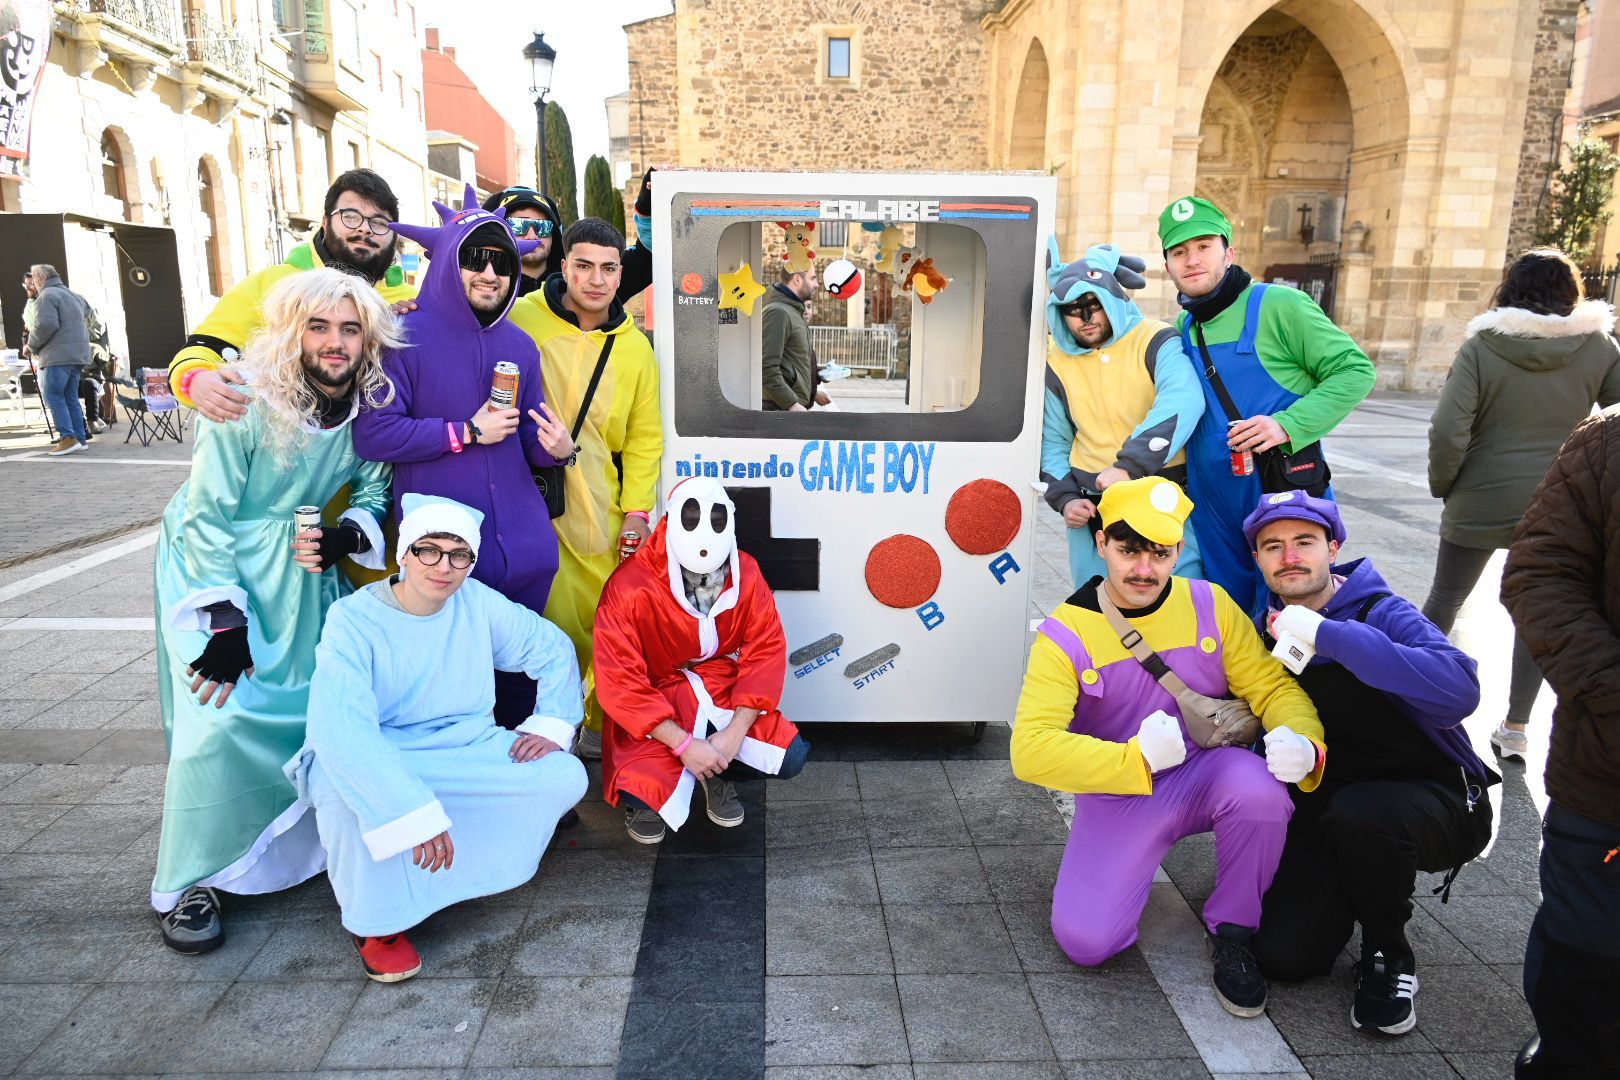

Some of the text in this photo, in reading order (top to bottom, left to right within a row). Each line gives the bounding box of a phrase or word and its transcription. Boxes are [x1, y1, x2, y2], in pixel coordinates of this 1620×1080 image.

[819, 199, 940, 222] CALABE
[1177, 203, 1189, 215] L
[678, 295, 715, 306] BATTERY
[675, 440, 936, 495] nintendo GAME BOY
[988, 552, 1021, 585] A
[915, 601, 945, 632] B
[793, 647, 841, 679] SELECT
[853, 659, 896, 690] START
